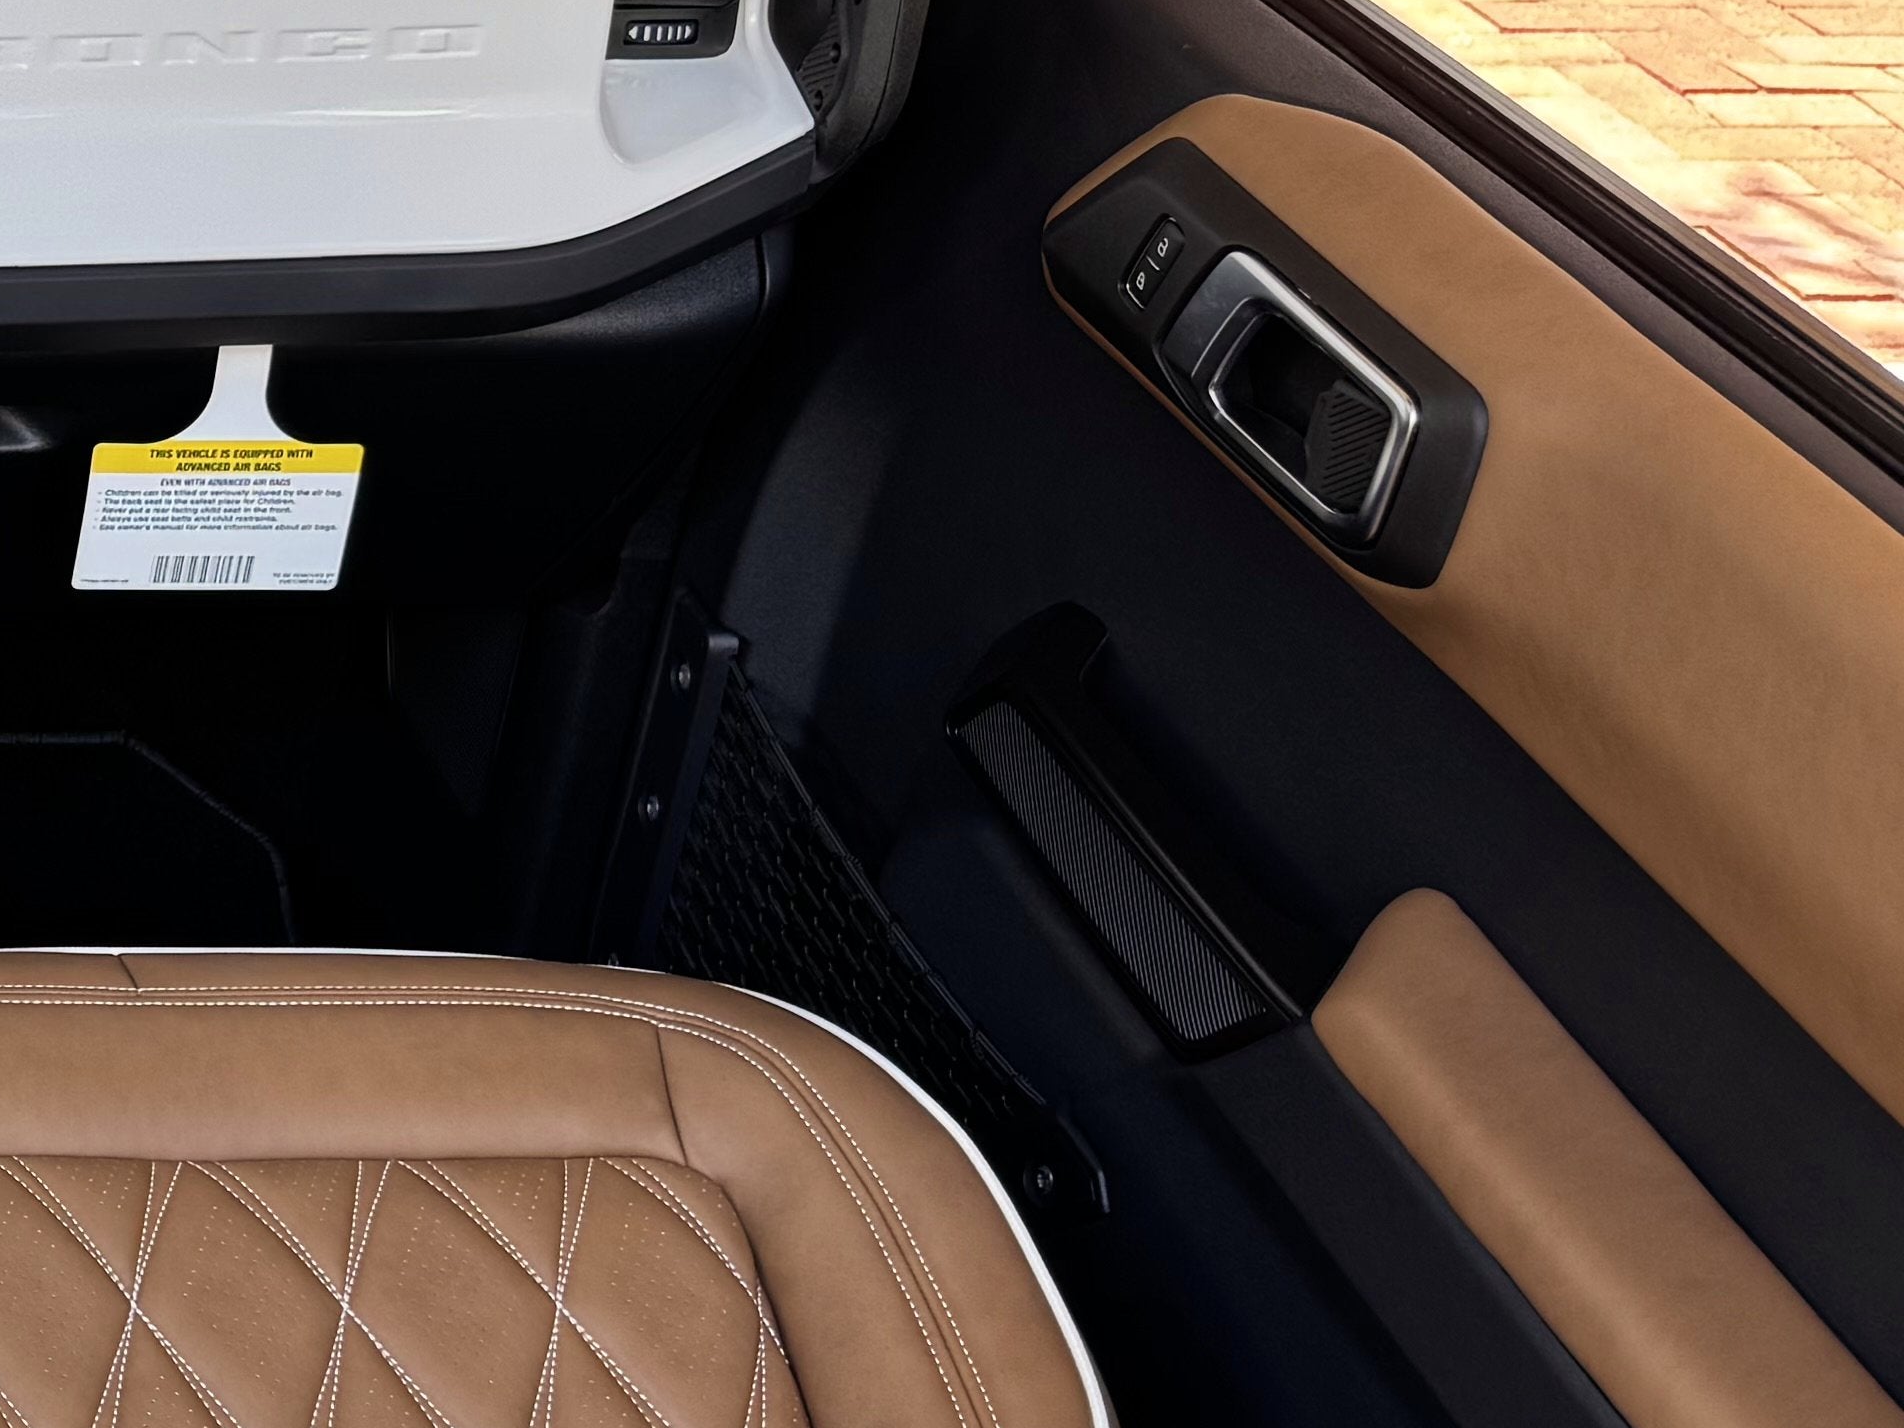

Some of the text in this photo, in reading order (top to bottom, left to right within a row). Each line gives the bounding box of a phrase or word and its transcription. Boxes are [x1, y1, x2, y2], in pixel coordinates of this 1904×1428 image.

[150, 449, 313, 459] THIS VEHICLE IS EQUIPPED WITH
[176, 462, 282, 472] ADVANCED AIR BAGS
